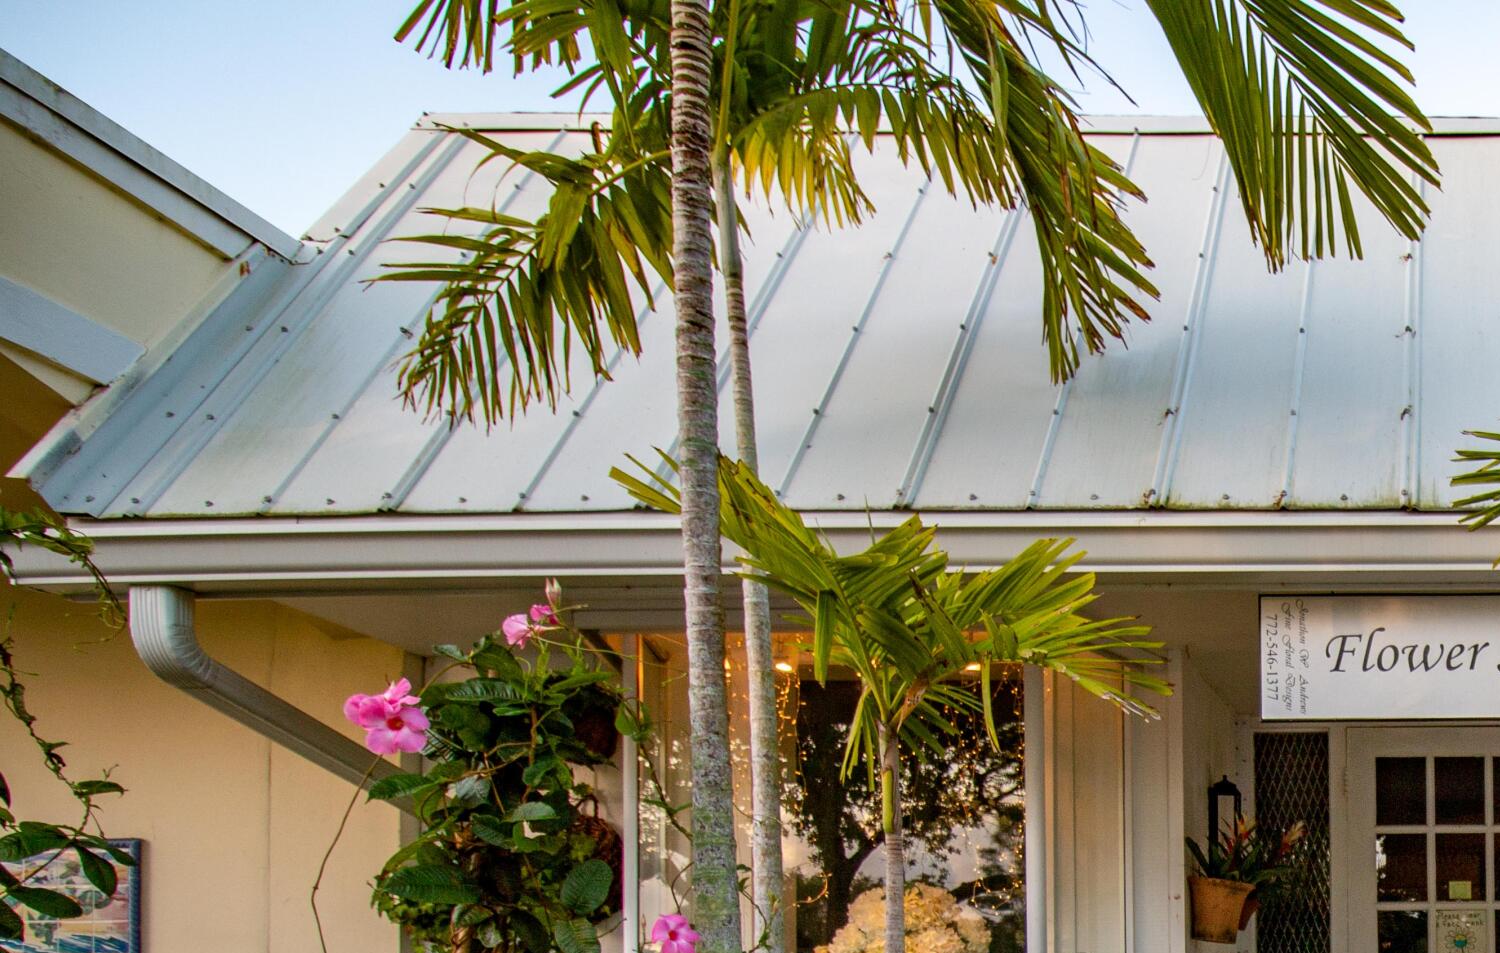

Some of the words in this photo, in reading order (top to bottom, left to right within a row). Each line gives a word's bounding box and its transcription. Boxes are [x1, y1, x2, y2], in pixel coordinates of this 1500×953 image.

[1281, 602, 1295, 631] Fine
[1266, 613, 1278, 701] 772-546-1377
[1282, 634, 1295, 669] Floral
[1325, 627, 1490, 673] Flower
[1282, 673, 1296, 711] Designs
